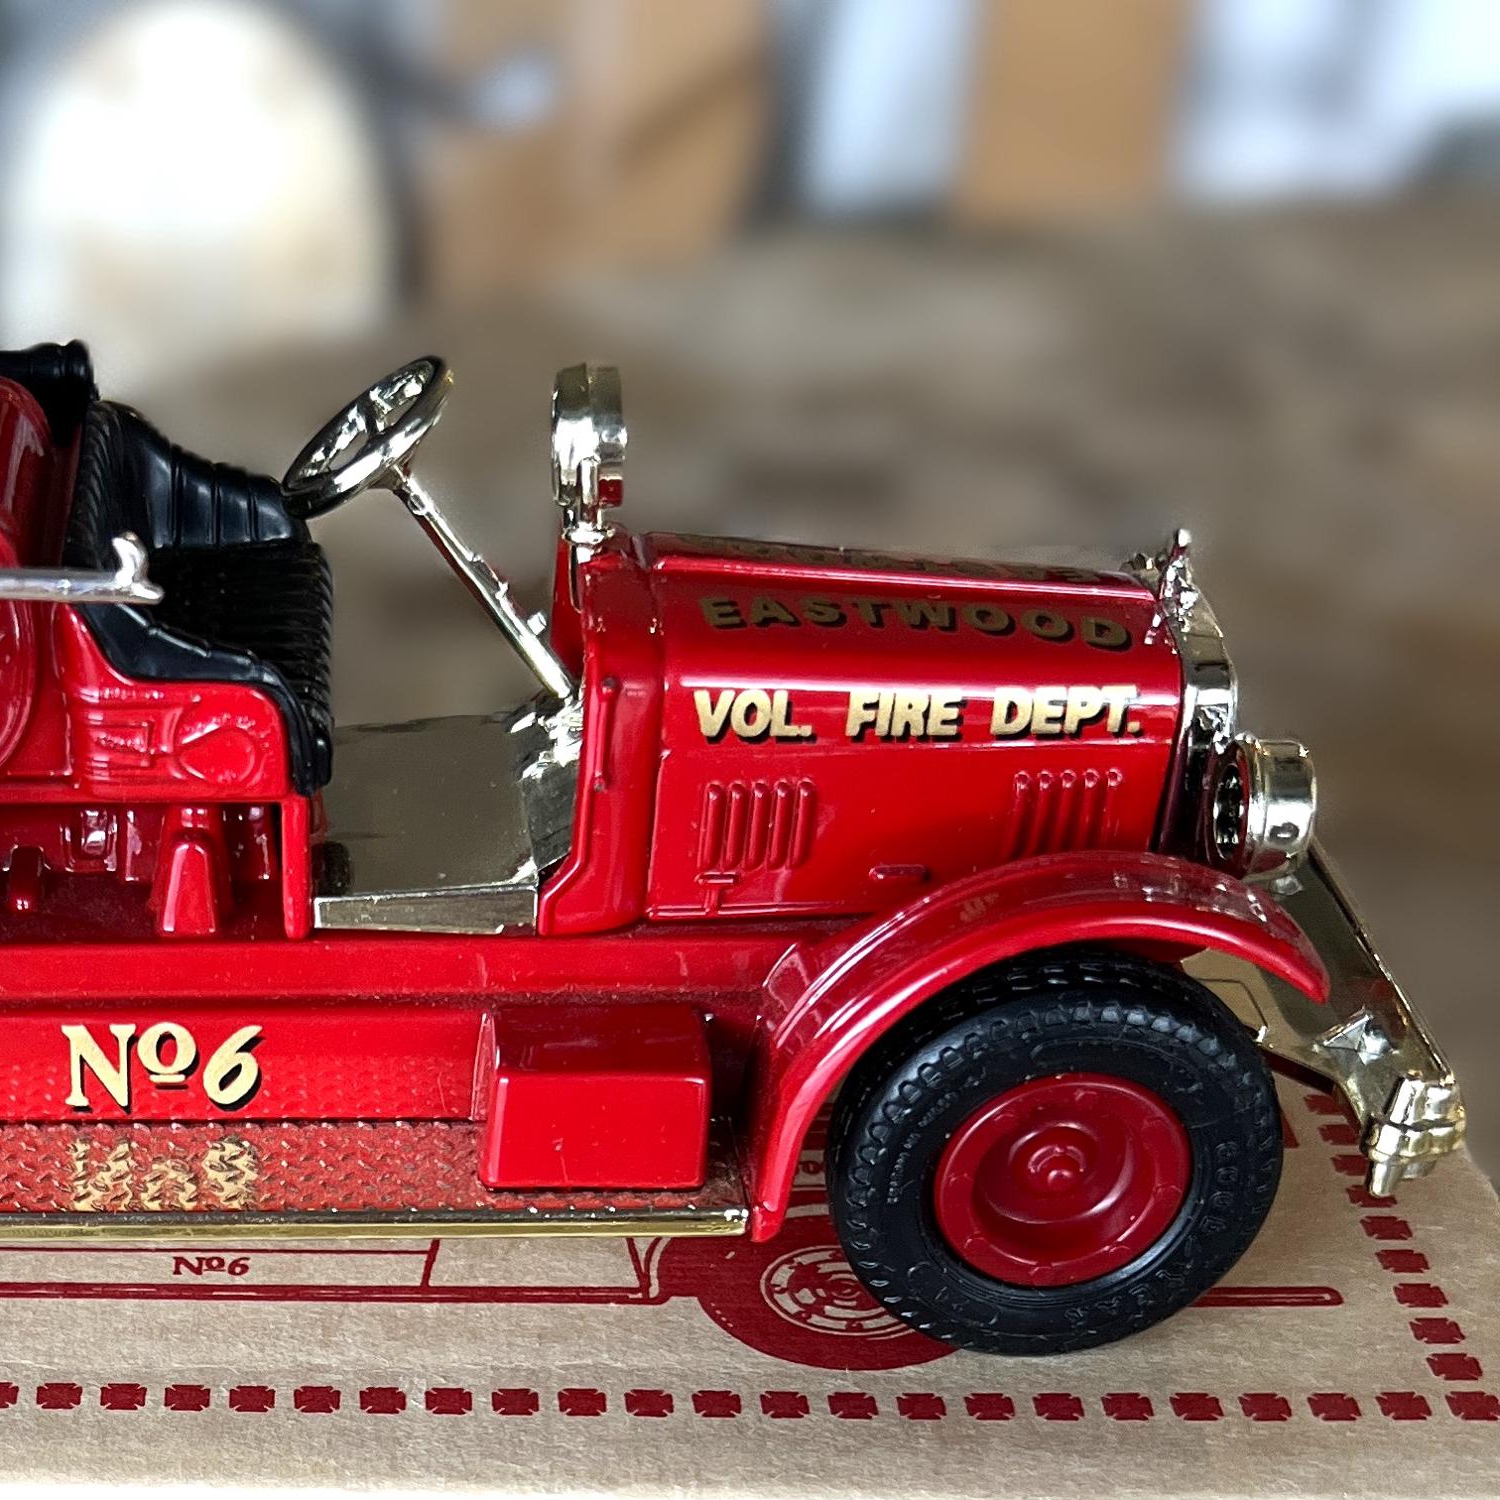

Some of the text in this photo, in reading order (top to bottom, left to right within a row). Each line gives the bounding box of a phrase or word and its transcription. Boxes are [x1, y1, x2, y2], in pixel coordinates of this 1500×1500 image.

[701, 597, 1133, 651] EASTWOOD
[694, 684, 1144, 742] VOL. FIRE DEPT.
